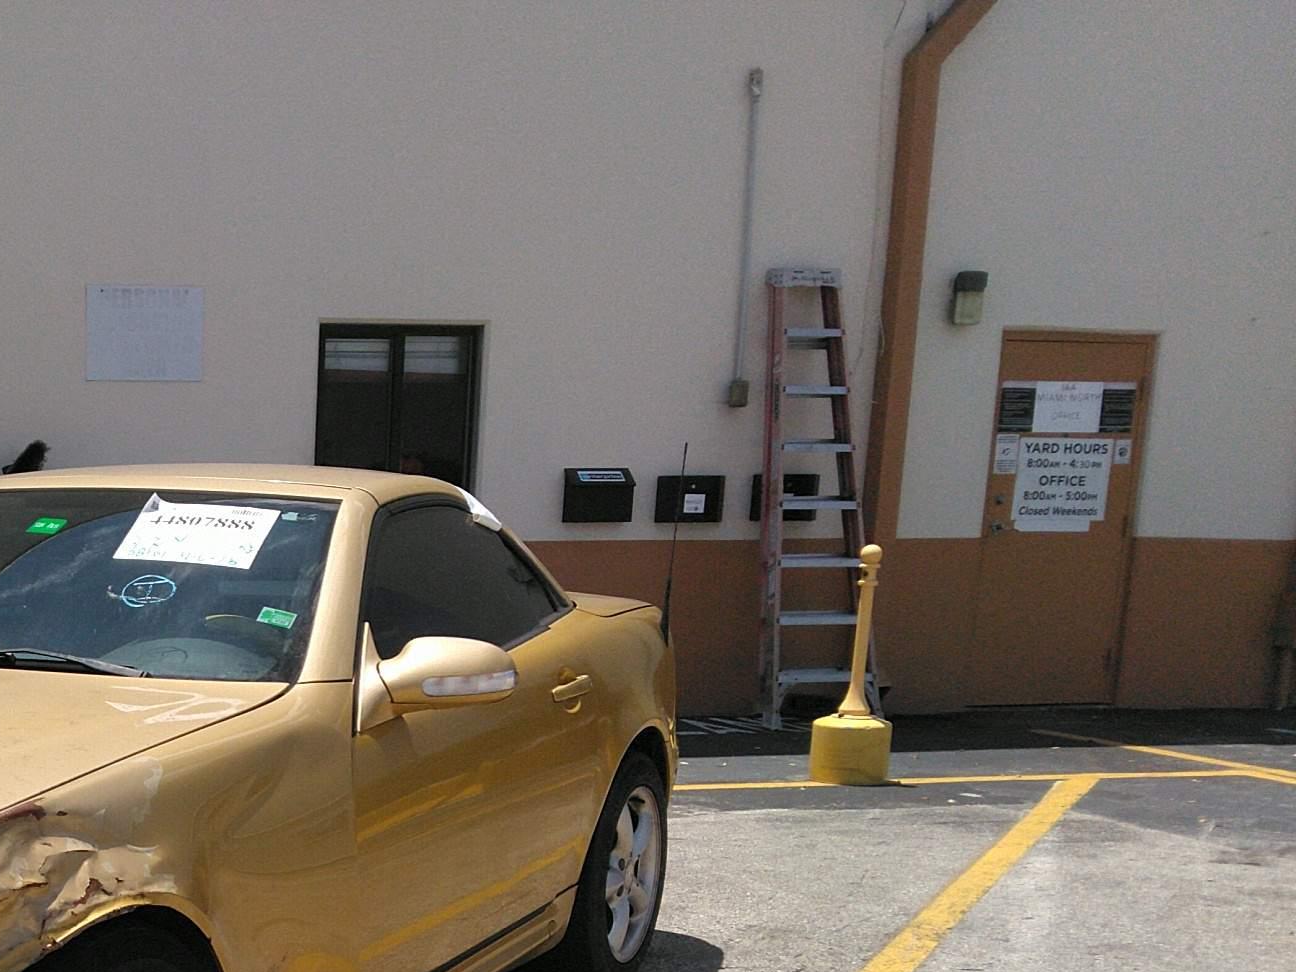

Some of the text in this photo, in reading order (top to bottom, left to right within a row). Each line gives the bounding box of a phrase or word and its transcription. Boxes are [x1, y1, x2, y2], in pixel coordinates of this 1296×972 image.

[1025, 443, 1109, 454] YARD HOURS
[1039, 475, 1086, 487] OFFICE
[1018, 506, 1098, 516] Closed Weekends
